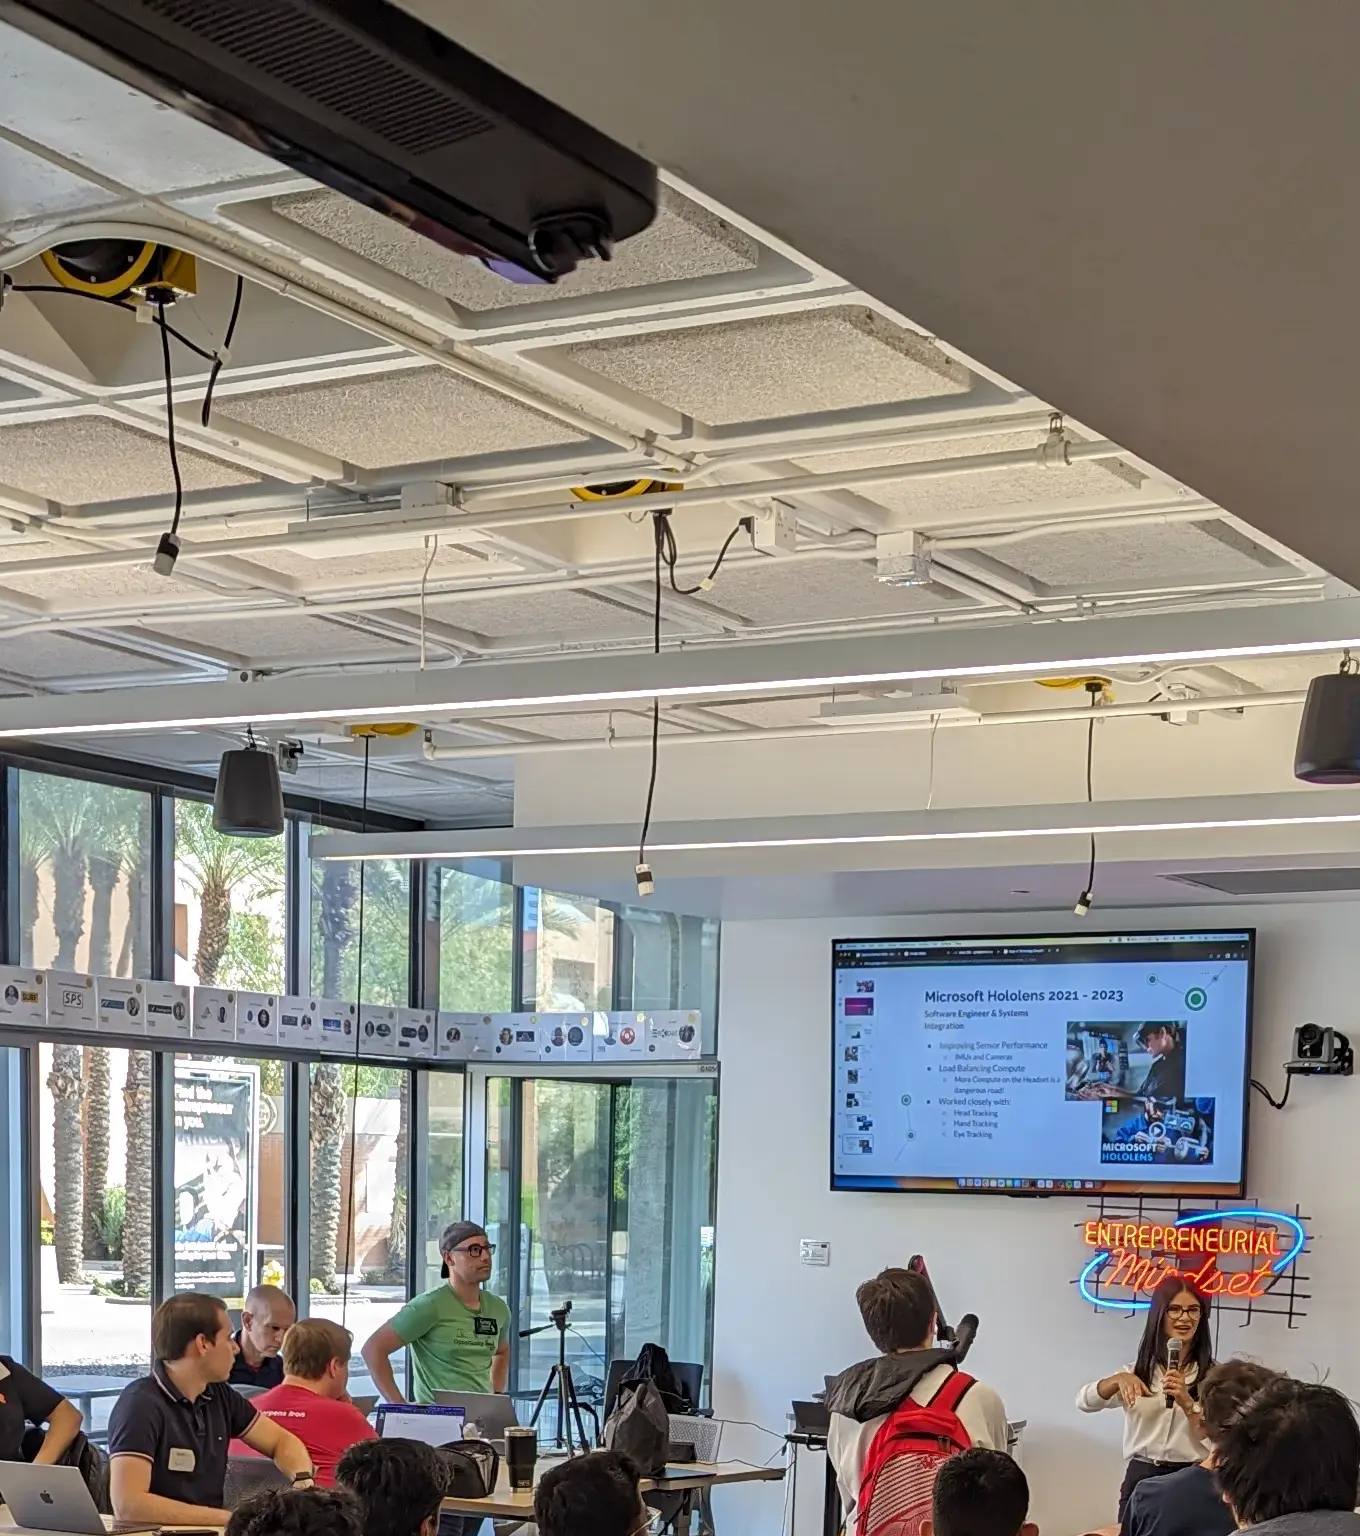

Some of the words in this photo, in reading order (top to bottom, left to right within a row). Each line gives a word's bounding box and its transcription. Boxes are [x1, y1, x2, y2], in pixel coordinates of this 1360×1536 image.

[64, 992, 82, 1006] SPS
[925, 989, 984, 1003] Microsoft
[988, 988, 1045, 1002] Hololens
[1048, 989, 1079, 1001] 2021
[1091, 989, 1124, 1002] 2023
[924, 1010, 957, 1018] Software
[958, 1009, 990, 1019] Engineer
[991, 1009, 997, 1017] &
[998, 1009, 1029, 1018] Systems
[924, 1022, 965, 1031] Integration
[939, 1041, 975, 1051] Improving
[976, 1041, 999, 1050] Sensor
[1001, 1041, 1048, 1050] Performance
[939, 1064, 956, 1073] Load
[957, 1064, 991, 1075] Balancing
[992, 1064, 1026, 1074] Compute
[954, 1076, 971, 1084] More
[972, 1076, 1001, 1085] Compute
[954, 1087, 987, 1095] dangerous
[175, 1099, 234, 1115] ntrepreneur
[939, 1098, 967, 1106] Worked
[967, 1098, 992, 1107] closely
[971, 1110, 998, 1119] Tracking
[971, 1120, 998, 1129] Tracking
[953, 1131, 965, 1139] Eye
[966, 1131, 992, 1140] Tracking
[1102, 1142, 1157, 1152] MICROSOFT
[1102, 1152, 1153, 1161] HOLOLENS
[1085, 1221, 1281, 1256] ENTREPRENEURIAL
